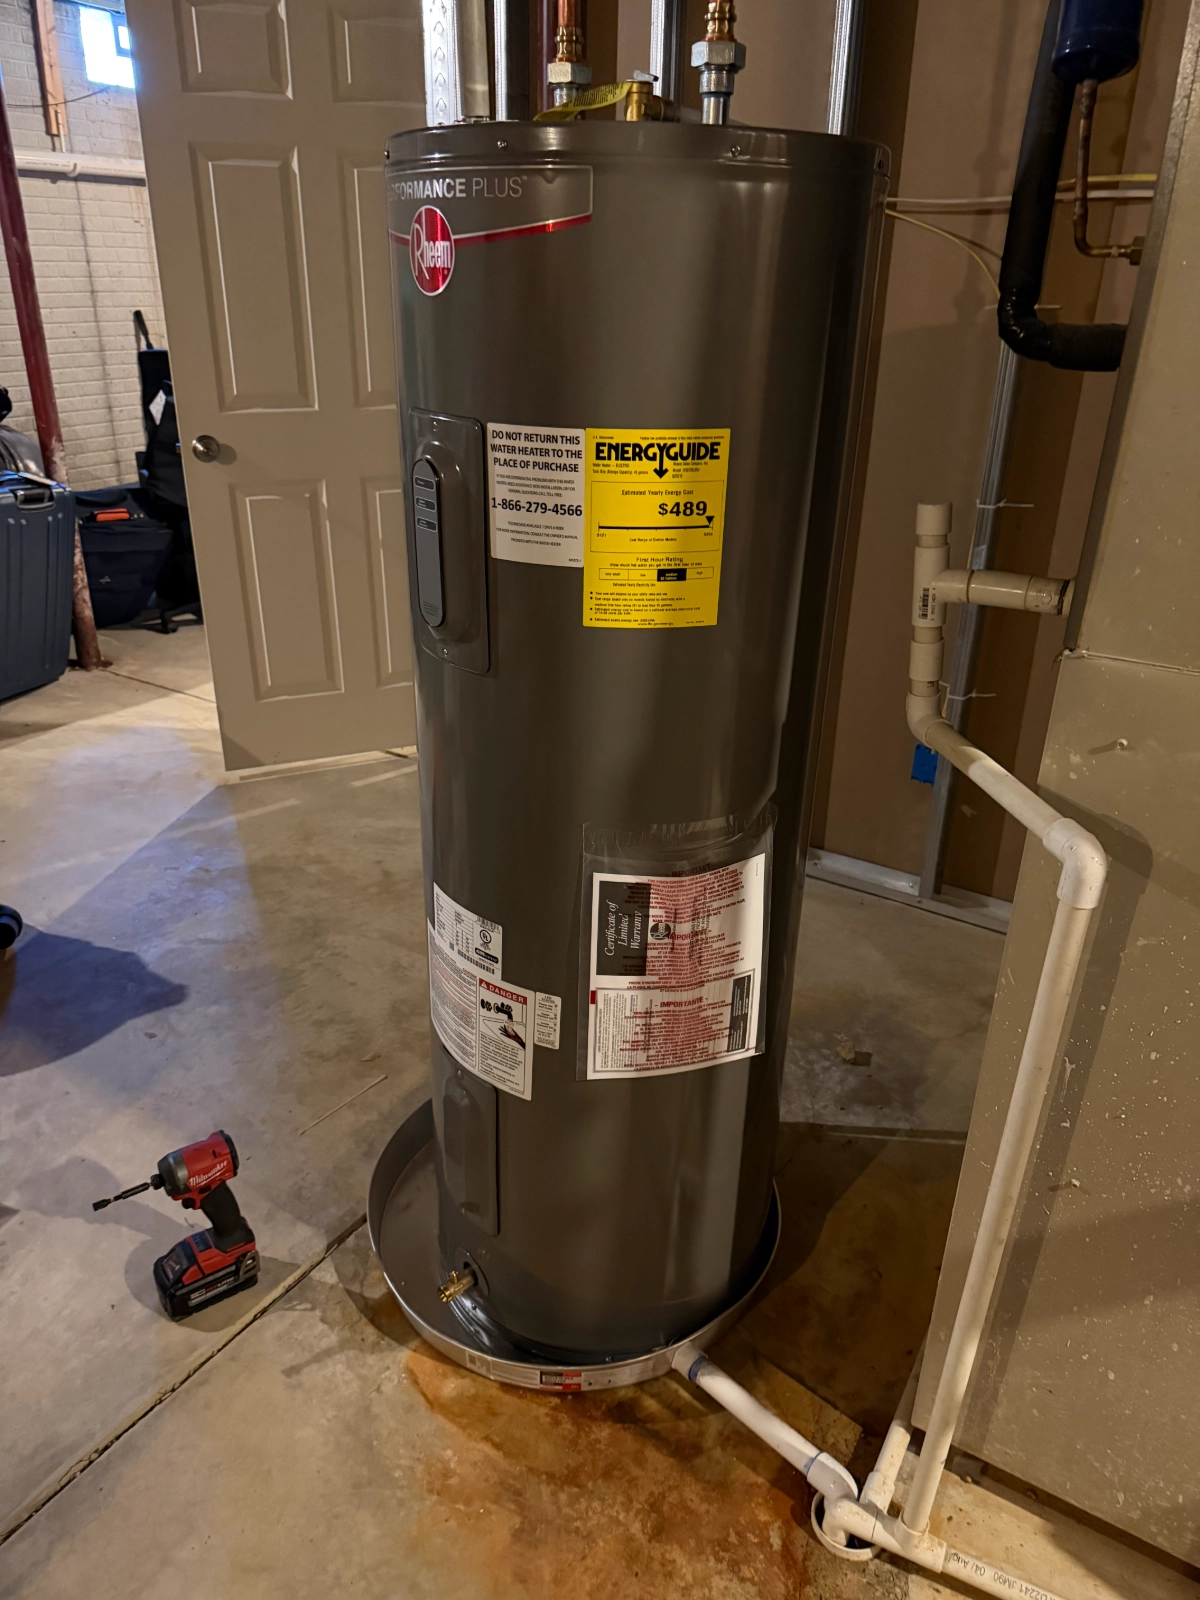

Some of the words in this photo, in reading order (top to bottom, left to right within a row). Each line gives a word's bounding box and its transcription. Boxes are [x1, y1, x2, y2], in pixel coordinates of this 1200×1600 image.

[413, 208, 451, 280] Rheem
[492, 429, 504, 440] DO
[505, 431, 522, 441] NOT
[524, 433, 558, 444] RETURN
[559, 435, 580, 445] THIS
[490, 443, 516, 454] WATER
[518, 446, 550, 457] HEATER
[551, 448, 563, 458] TO
[565, 449, 583, 459] THE
[595, 441, 721, 462] ENERGYGUIDE
[493, 457, 518, 468] PLACE
[519, 460, 531, 469] OF
[532, 461, 579, 473] PURCHASE
[647, 489, 663, 497] Yearly
[664, 489, 682, 497] Energy
[491, 497, 583, 517] 1-866-279-4566
[658, 500, 708, 517] $489
[606, 899, 619, 911] of
[604, 912, 618, 956] Certificate
[630, 910, 645, 949] Warranty
[489, 984, 525, 1004] DANGER
[660, 996, 704, 1008] IMPORTANTE
[189, 1160, 228, 1187] Milwaukee
[993, 1571, 1017, 1589] JM90
